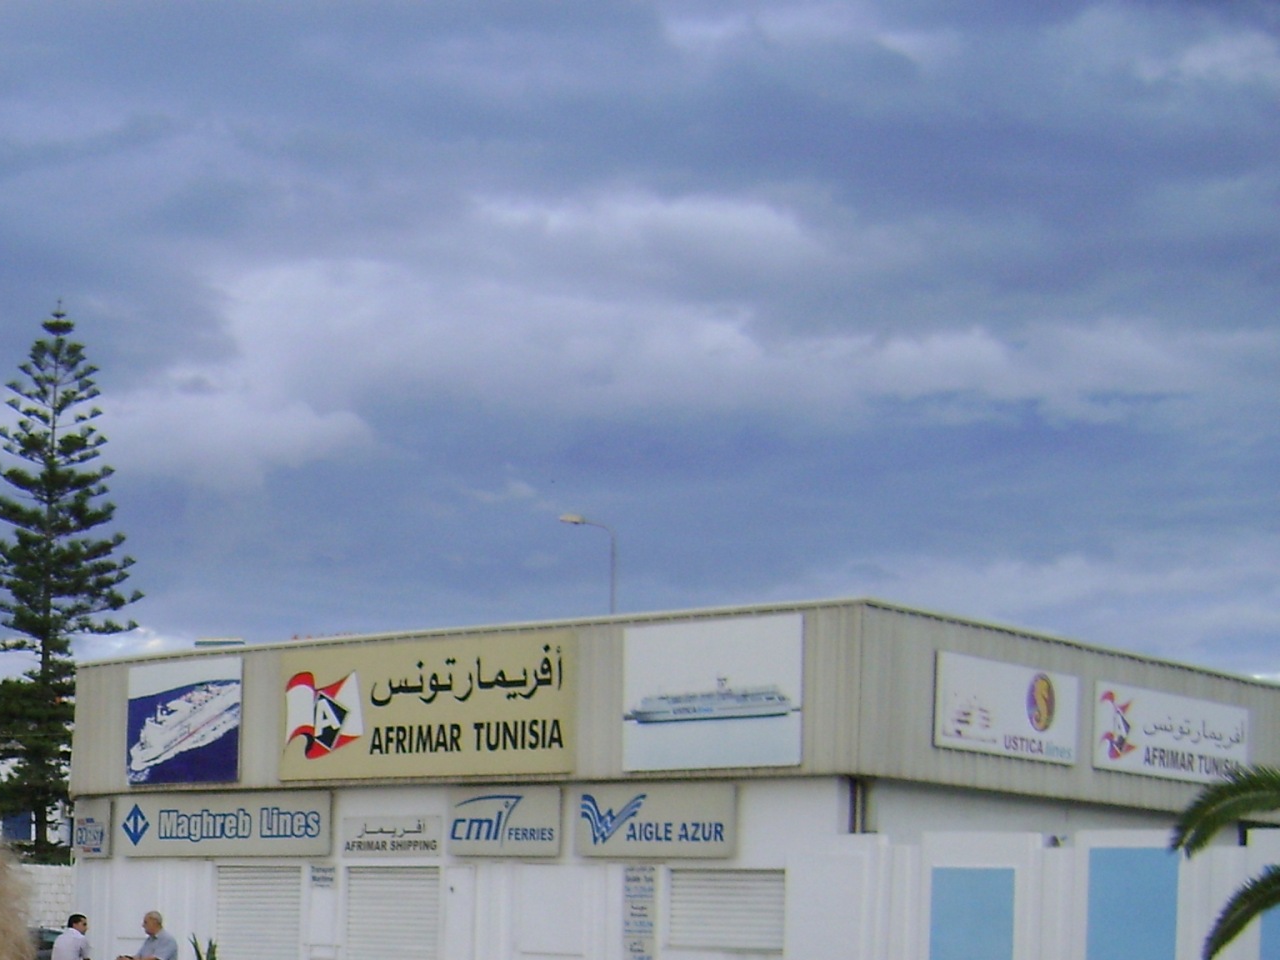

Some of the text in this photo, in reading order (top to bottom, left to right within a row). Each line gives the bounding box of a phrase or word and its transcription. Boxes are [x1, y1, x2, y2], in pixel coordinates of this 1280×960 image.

[370, 719, 563, 755] AFRIMAR TUNISIA
[1004, 734, 1044, 755] USTICA
[1144, 746, 1194, 772] AFRIMAR
[159, 807, 320, 842] Maghreb Lines
[508, 827, 554, 841] FERRIES
[626, 822, 724, 842] AIGLE AZUR
[344, 840, 438, 852] AFRIMAR SHIPPING
